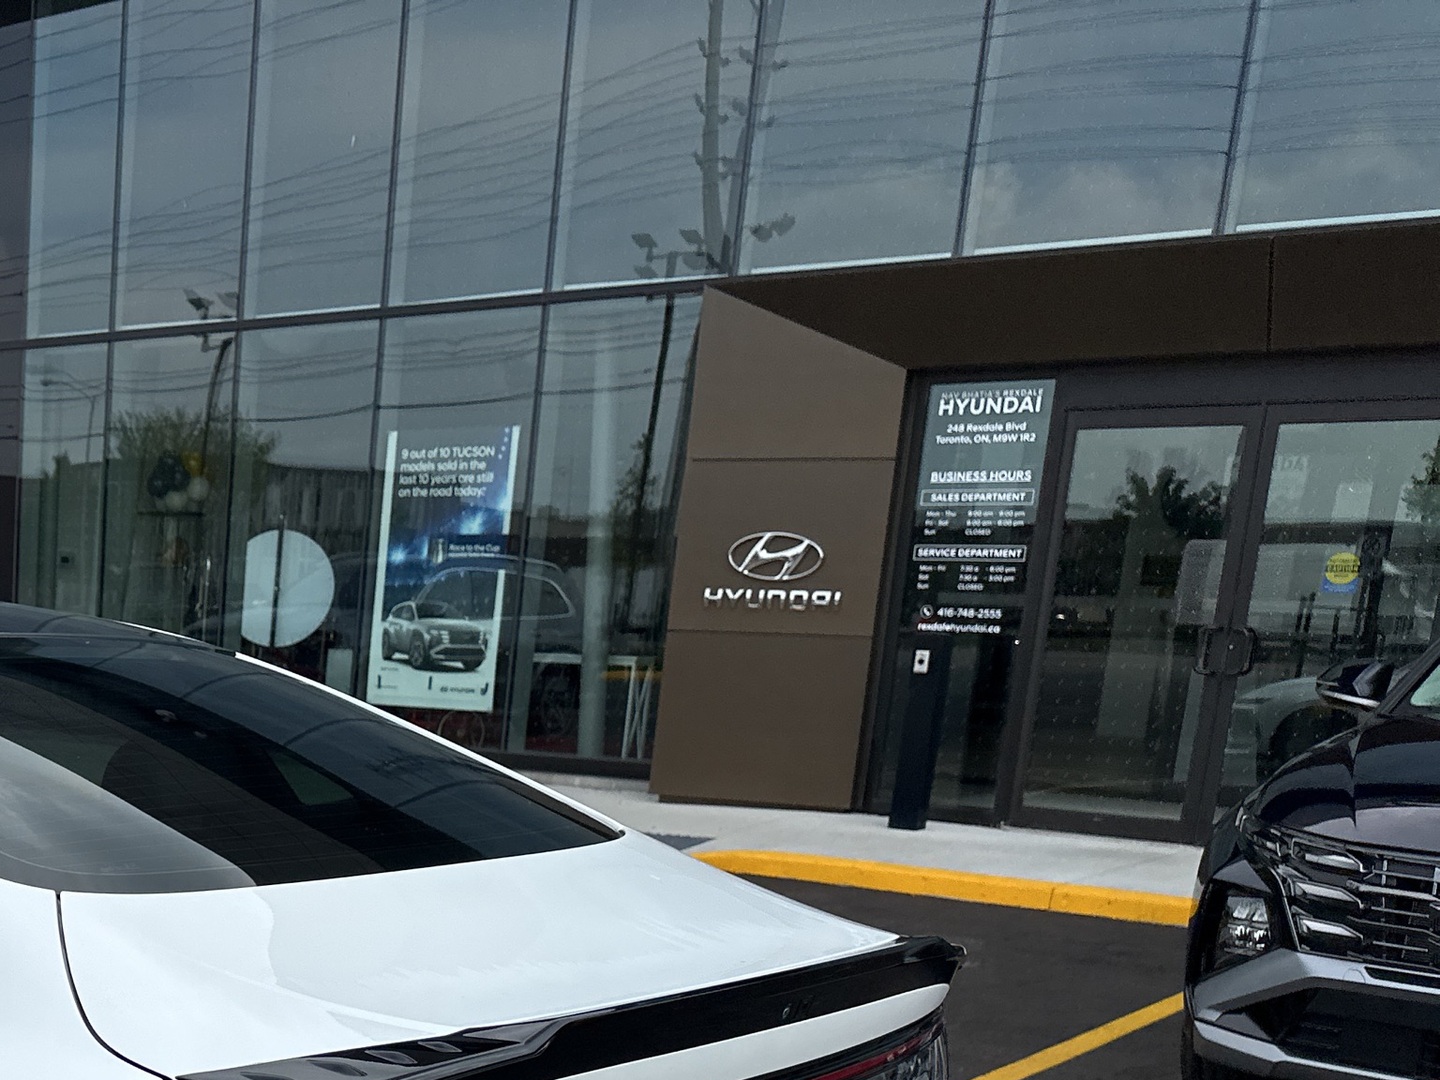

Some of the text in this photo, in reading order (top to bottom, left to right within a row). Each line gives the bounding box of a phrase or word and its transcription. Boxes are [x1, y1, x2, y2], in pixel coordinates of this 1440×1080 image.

[1002, 388, 1044, 397] REXDALE
[938, 396, 1042, 416] HYUNDAI
[946, 421, 1027, 434] 248 Rexdale Blvd
[935, 434, 972, 445] Toronto,
[992, 433, 1018, 443] M9W
[1019, 432, 1036, 442] 1R2
[401, 445, 496, 460] 9 out of 10 TUCSON
[400, 459, 487, 473] models sold in the
[399, 471, 494, 486] last 10 years are still
[930, 469, 1032, 483] BUSINESS HOURS
[398, 487, 411, 498] on
[412, 486, 429, 497] the
[429, 485, 452, 497] road
[930, 491, 1026, 502] SALES DEPARTMENT
[917, 547, 1023, 558] SERVICE DEPARTMENT
[703, 587, 842, 611] HYUNDAI
[936, 607, 1003, 619] 416-748-2555
[917, 622, 1001, 634] rexdalehyundai.ca
